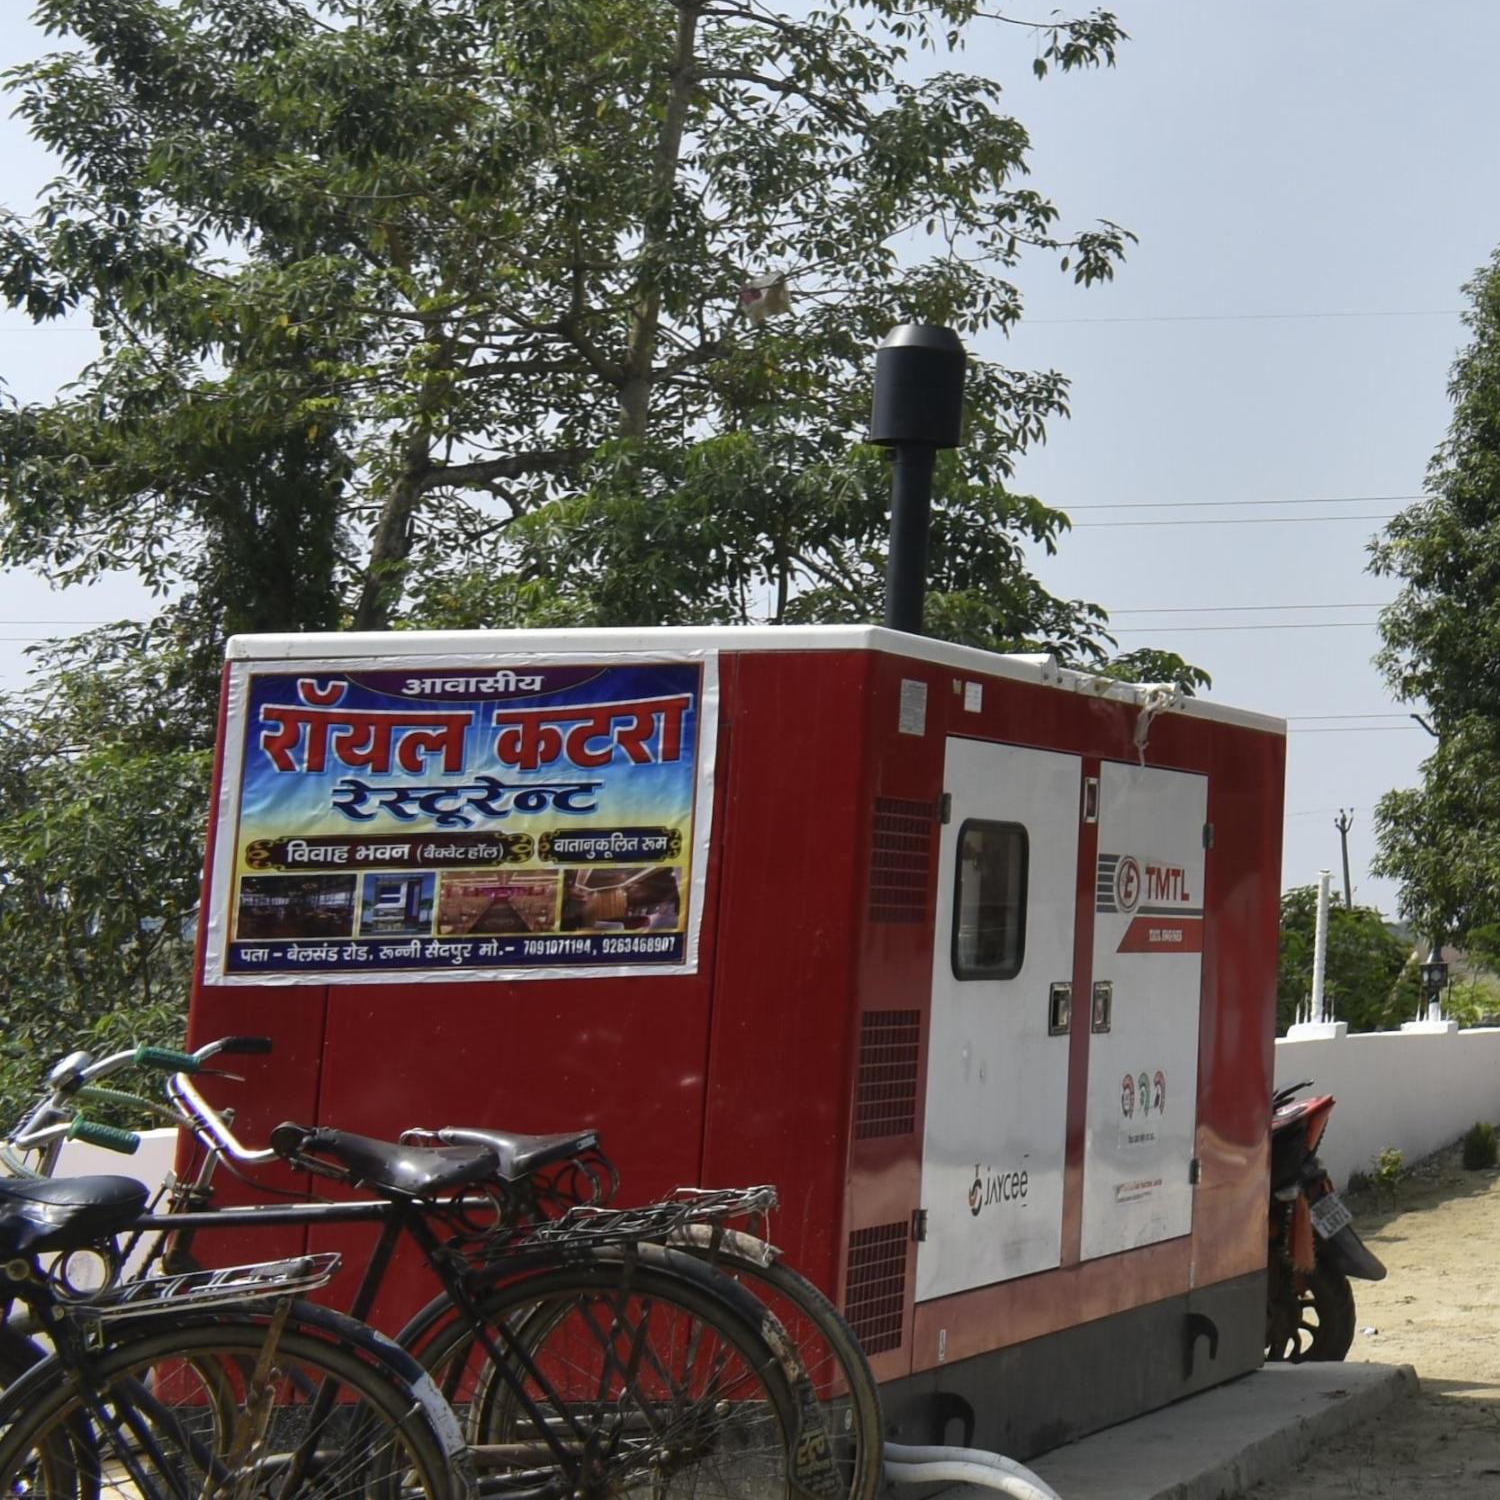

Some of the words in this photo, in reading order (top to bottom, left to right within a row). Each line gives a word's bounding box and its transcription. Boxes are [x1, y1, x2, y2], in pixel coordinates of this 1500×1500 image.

[402, 671, 545, 695] आवासीय
[260, 678, 477, 774] रॉयल
[493, 694, 694, 774] कटरा
[286, 840, 351, 863] विवाह
[355, 843, 411, 861] भवन
[553, 832, 639, 859] वातानुकूलित
[642, 836, 668, 851] रूम
[1145, 866, 1190, 901] TMTL
[240, 948, 270, 962] पता
[424, 939, 474, 964] सैदपुर
[523, 939, 597, 956] 7091071194,
[602, 937, 675, 954] 9263468907
